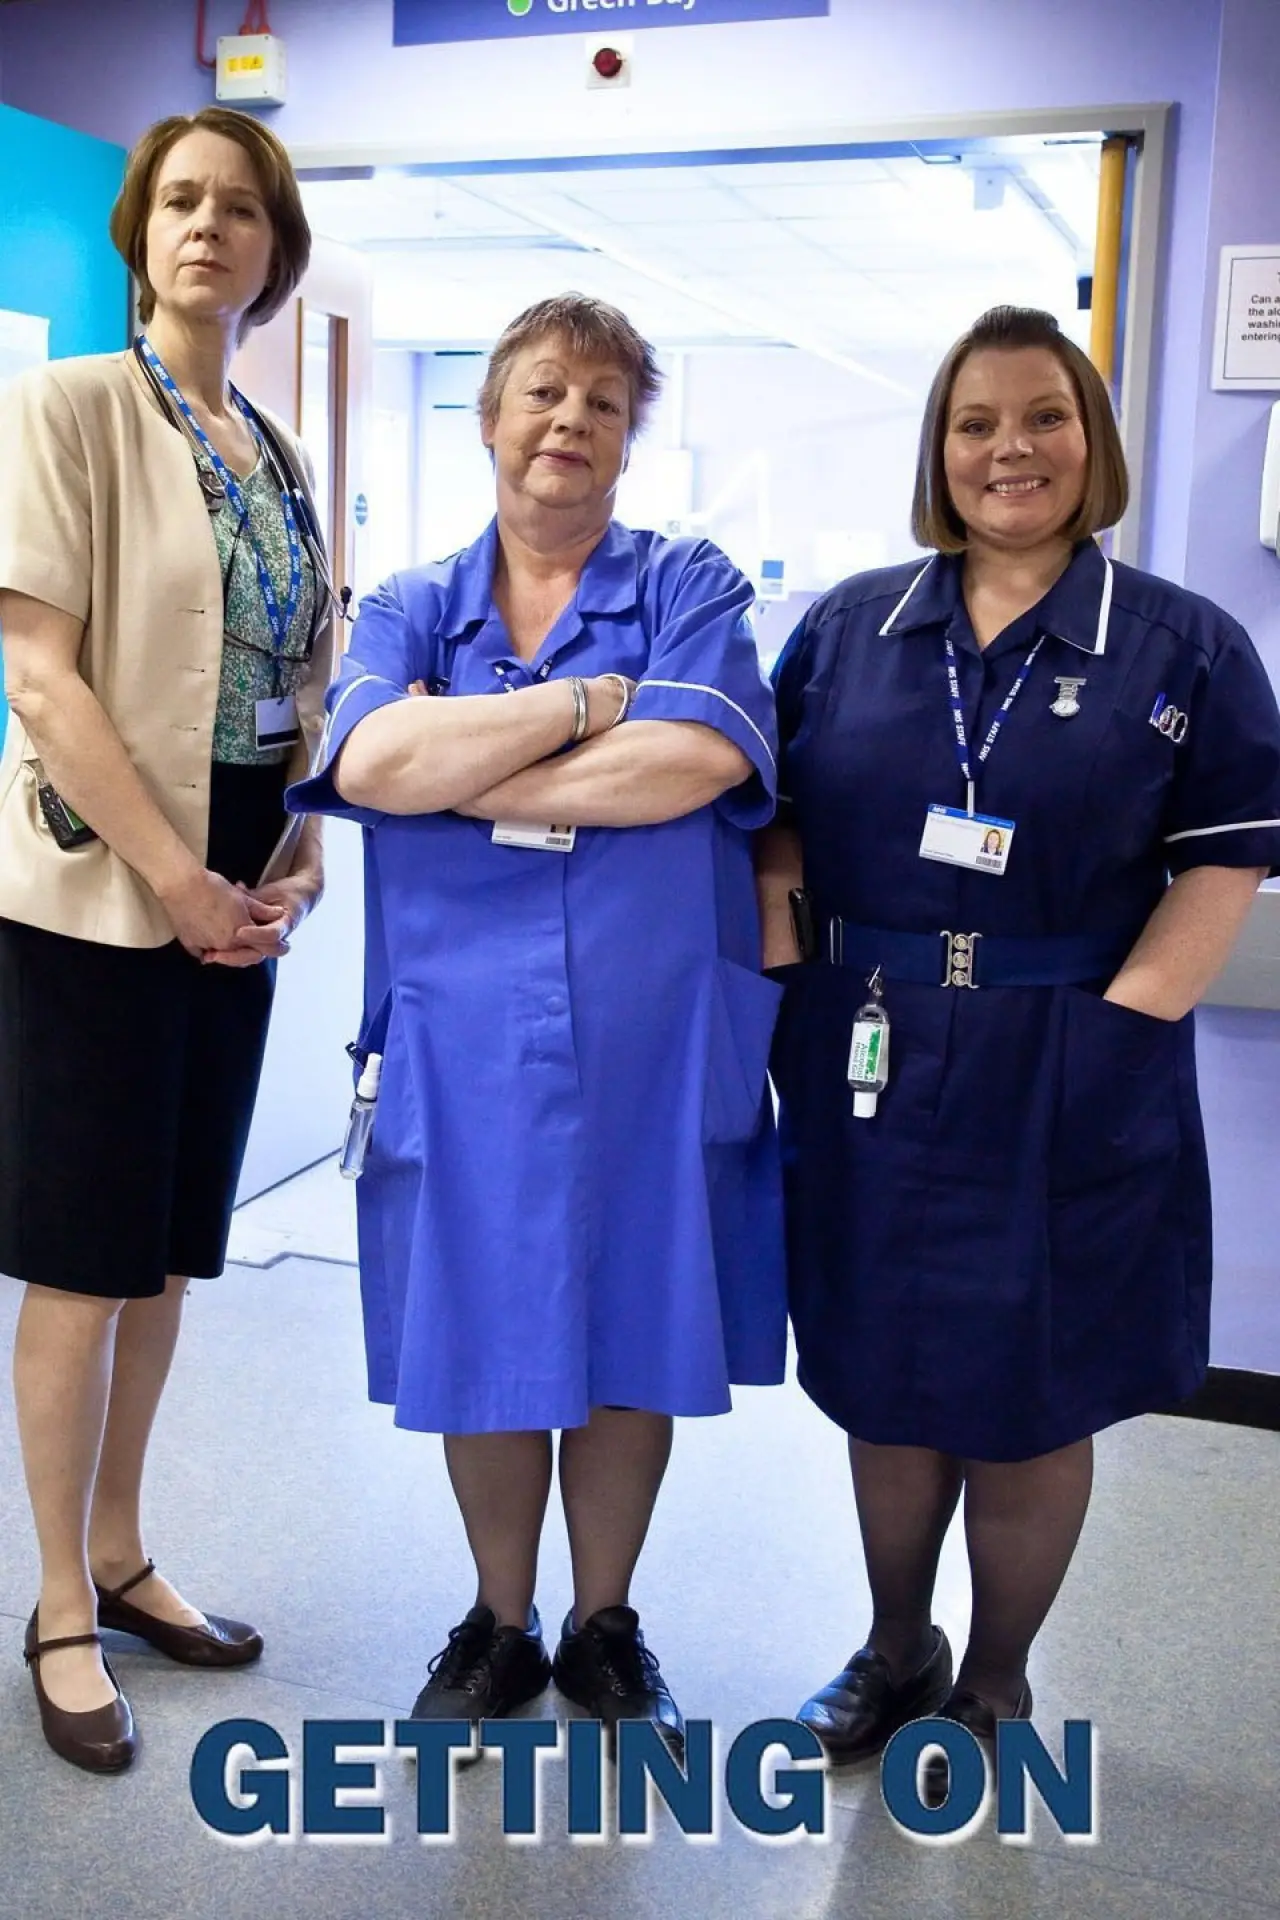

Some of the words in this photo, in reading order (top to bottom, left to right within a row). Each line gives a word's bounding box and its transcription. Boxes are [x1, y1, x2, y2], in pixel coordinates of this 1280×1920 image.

[1248, 307, 1265, 317] the
[1251, 294, 1272, 305] Can
[949, 679, 960, 698] STAFF
[955, 725, 967, 746] STAFF
[977, 744, 992, 763] NHS
[985, 721, 1001, 744] STAFF
